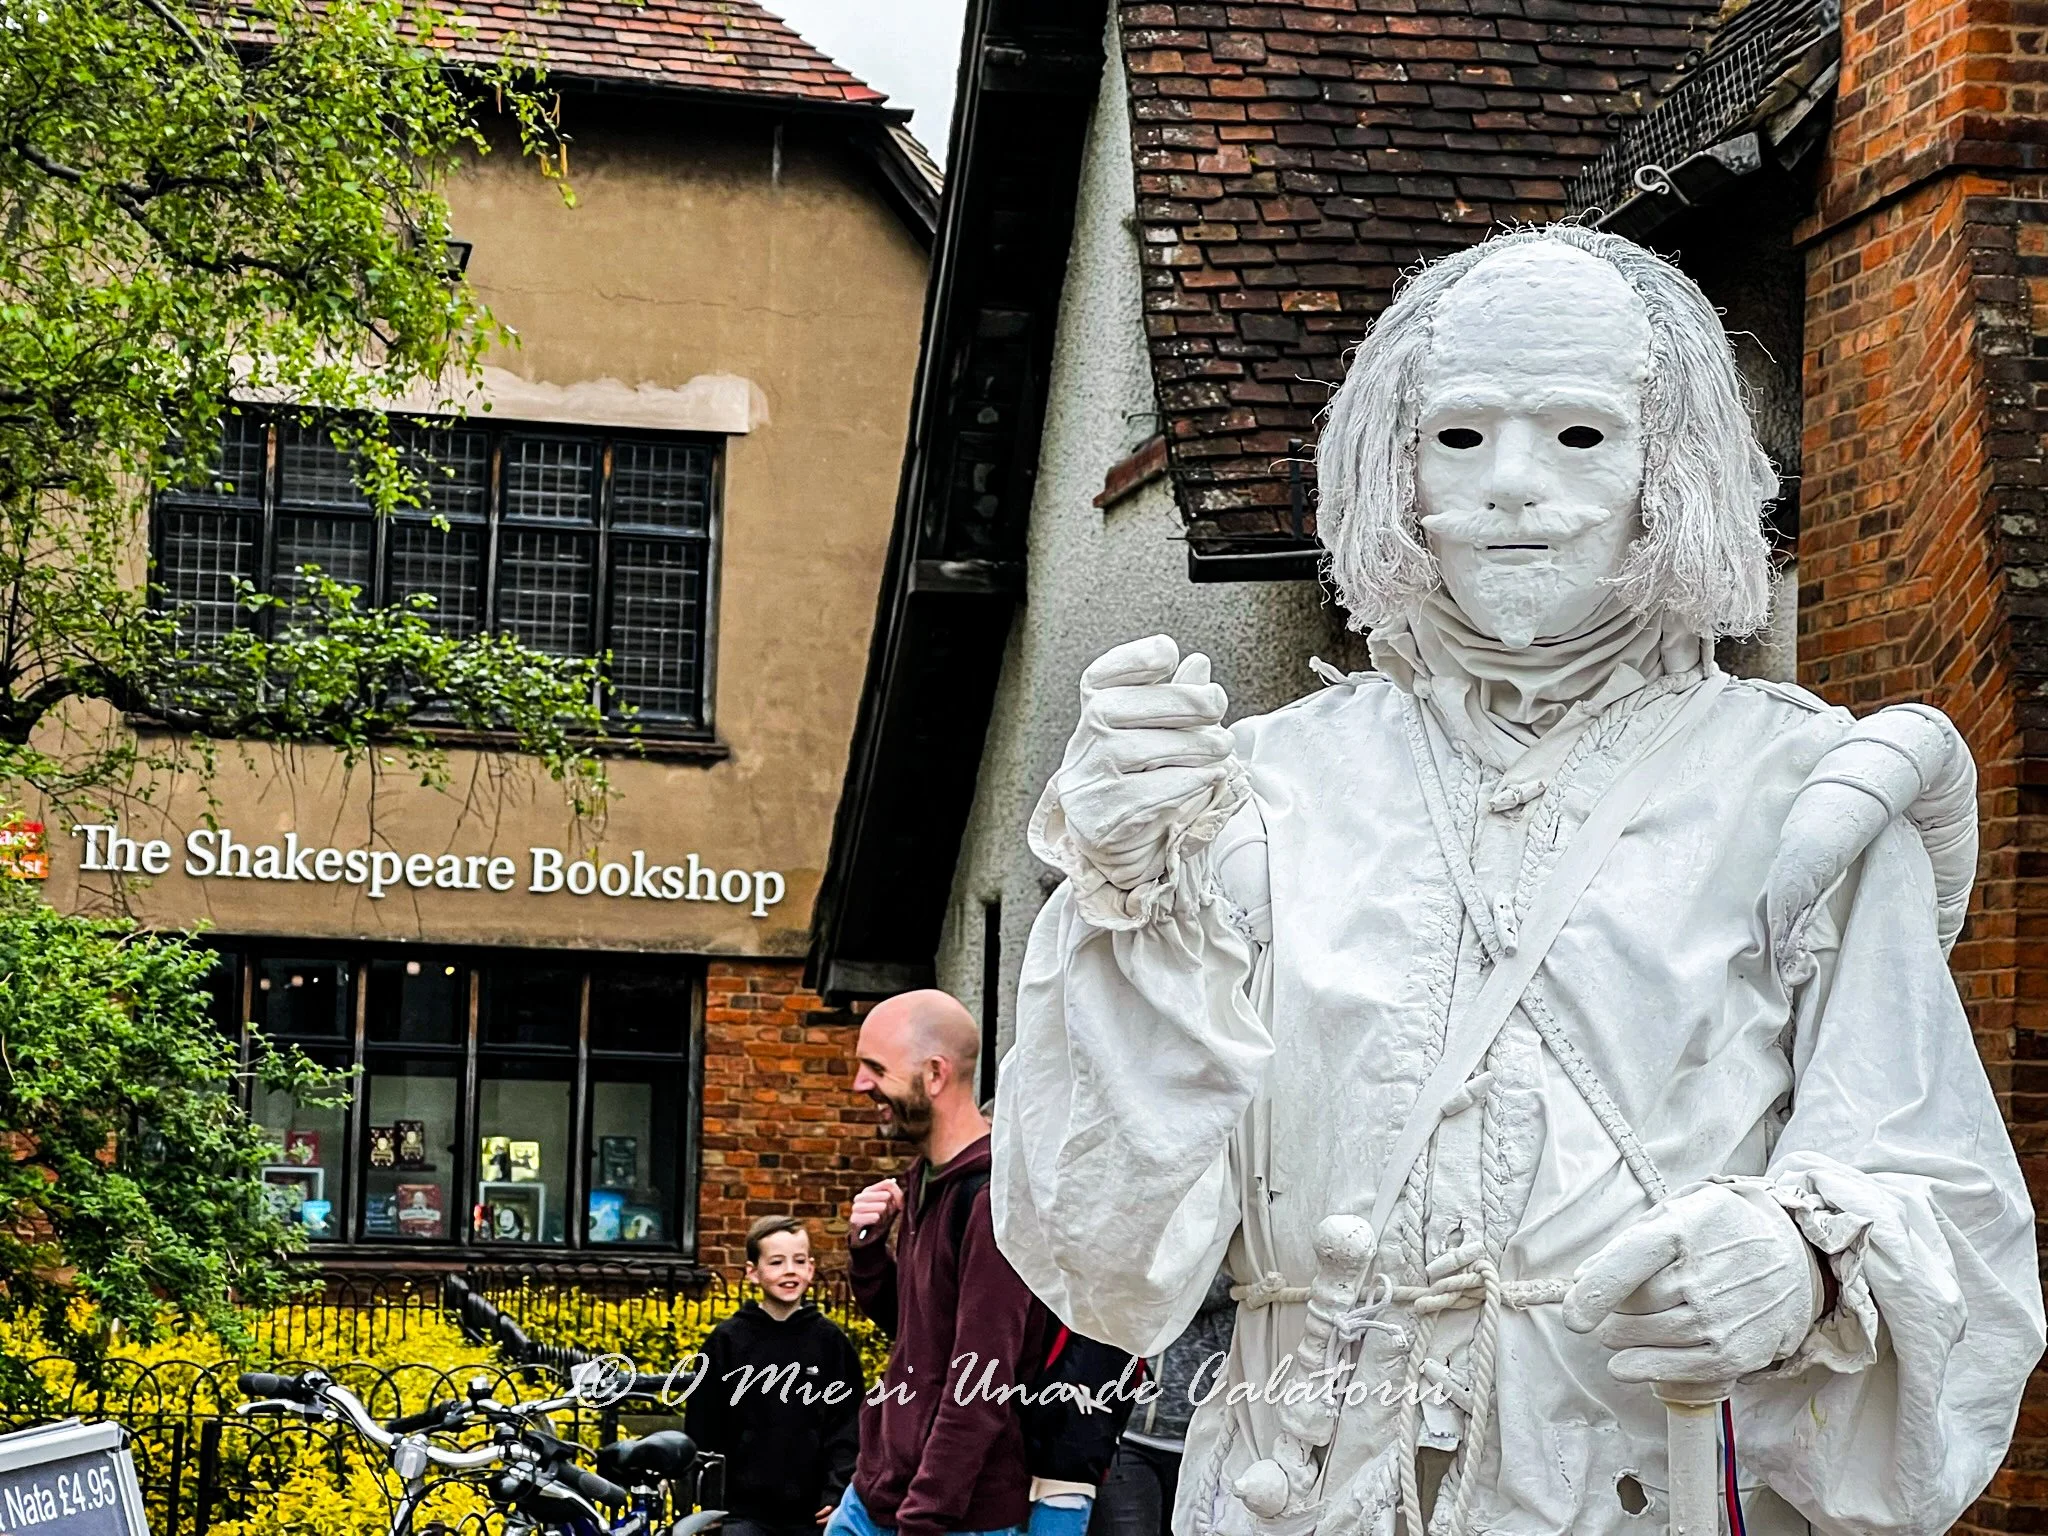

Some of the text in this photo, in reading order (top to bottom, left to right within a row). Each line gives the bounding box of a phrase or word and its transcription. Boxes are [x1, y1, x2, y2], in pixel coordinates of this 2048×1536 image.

[71, 823, 786, 917] The Shakespeare Bookshop
[4, 1483, 58, 1529] Nata
[57, 1466, 116, 1516] £4.95
